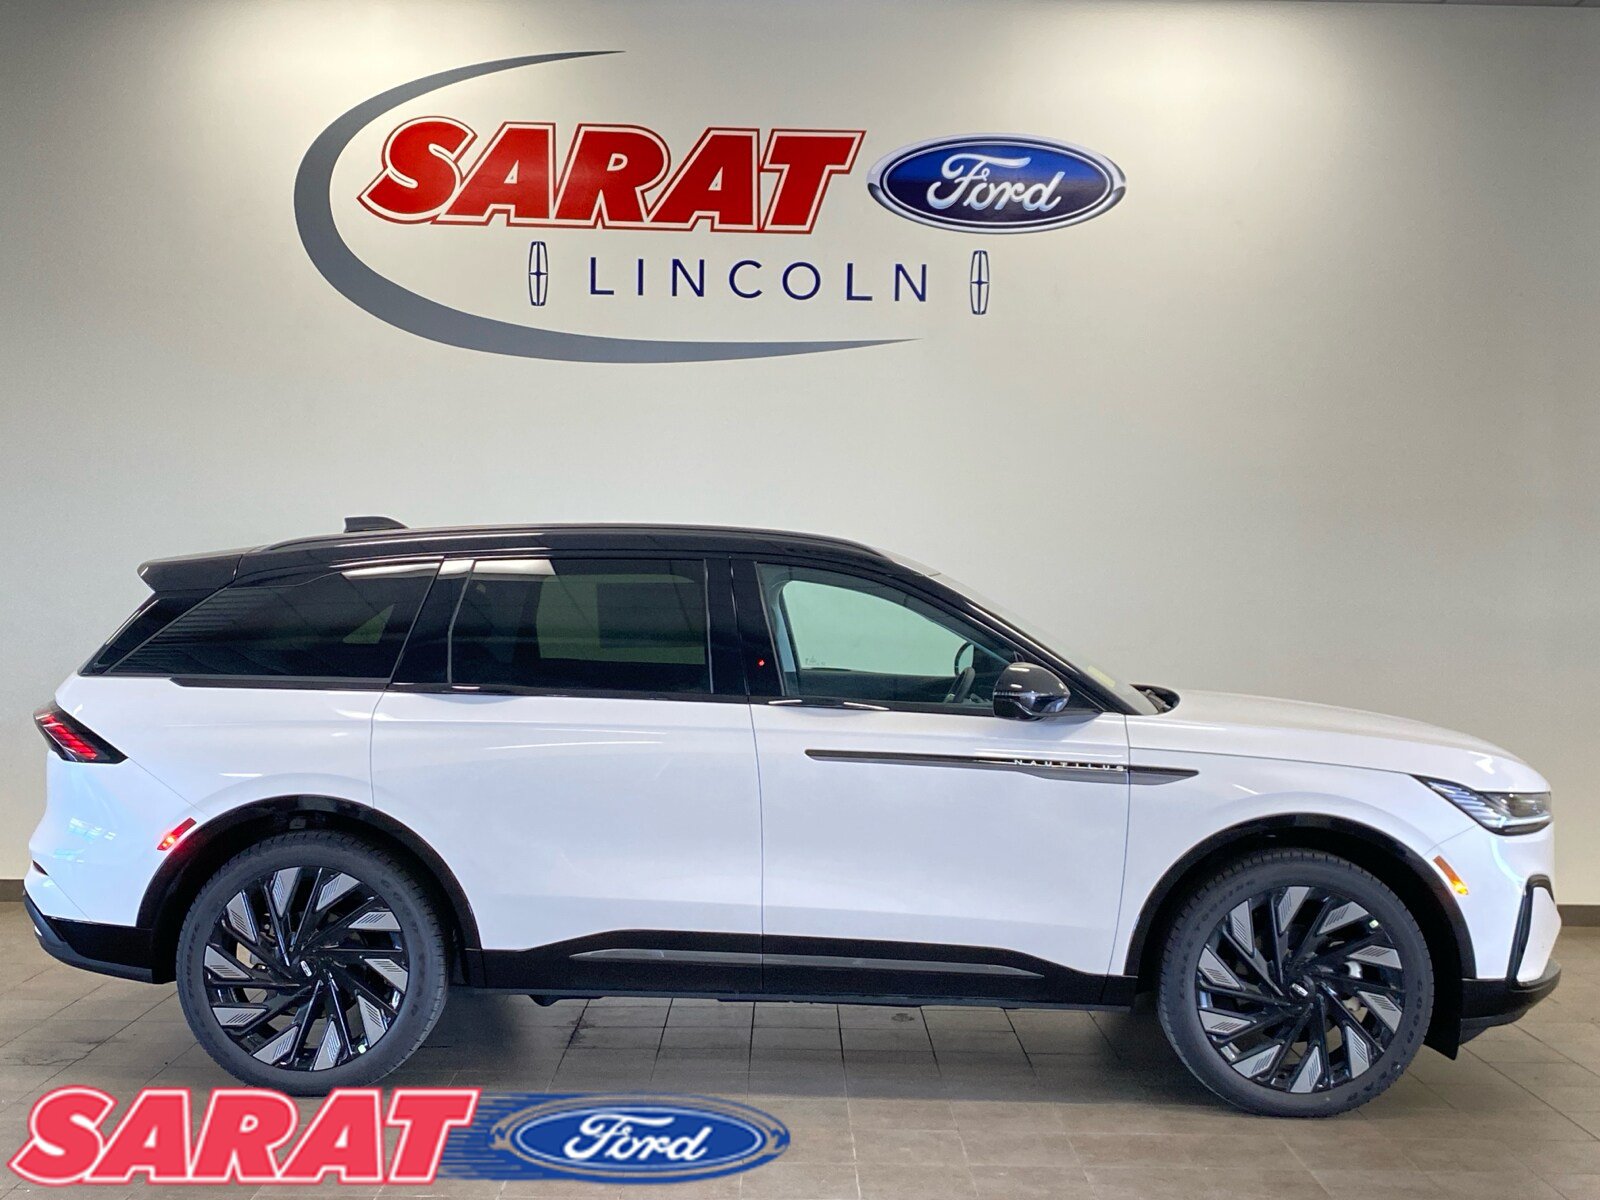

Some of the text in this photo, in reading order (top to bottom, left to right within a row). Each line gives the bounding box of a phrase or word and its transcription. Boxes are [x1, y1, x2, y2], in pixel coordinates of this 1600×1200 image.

[357, 116, 866, 235] SARAT
[926, 153, 1066, 212] Ford
[590, 256, 928, 302] LINCOLN
[1014, 759, 1124, 772] NAUTILUS
